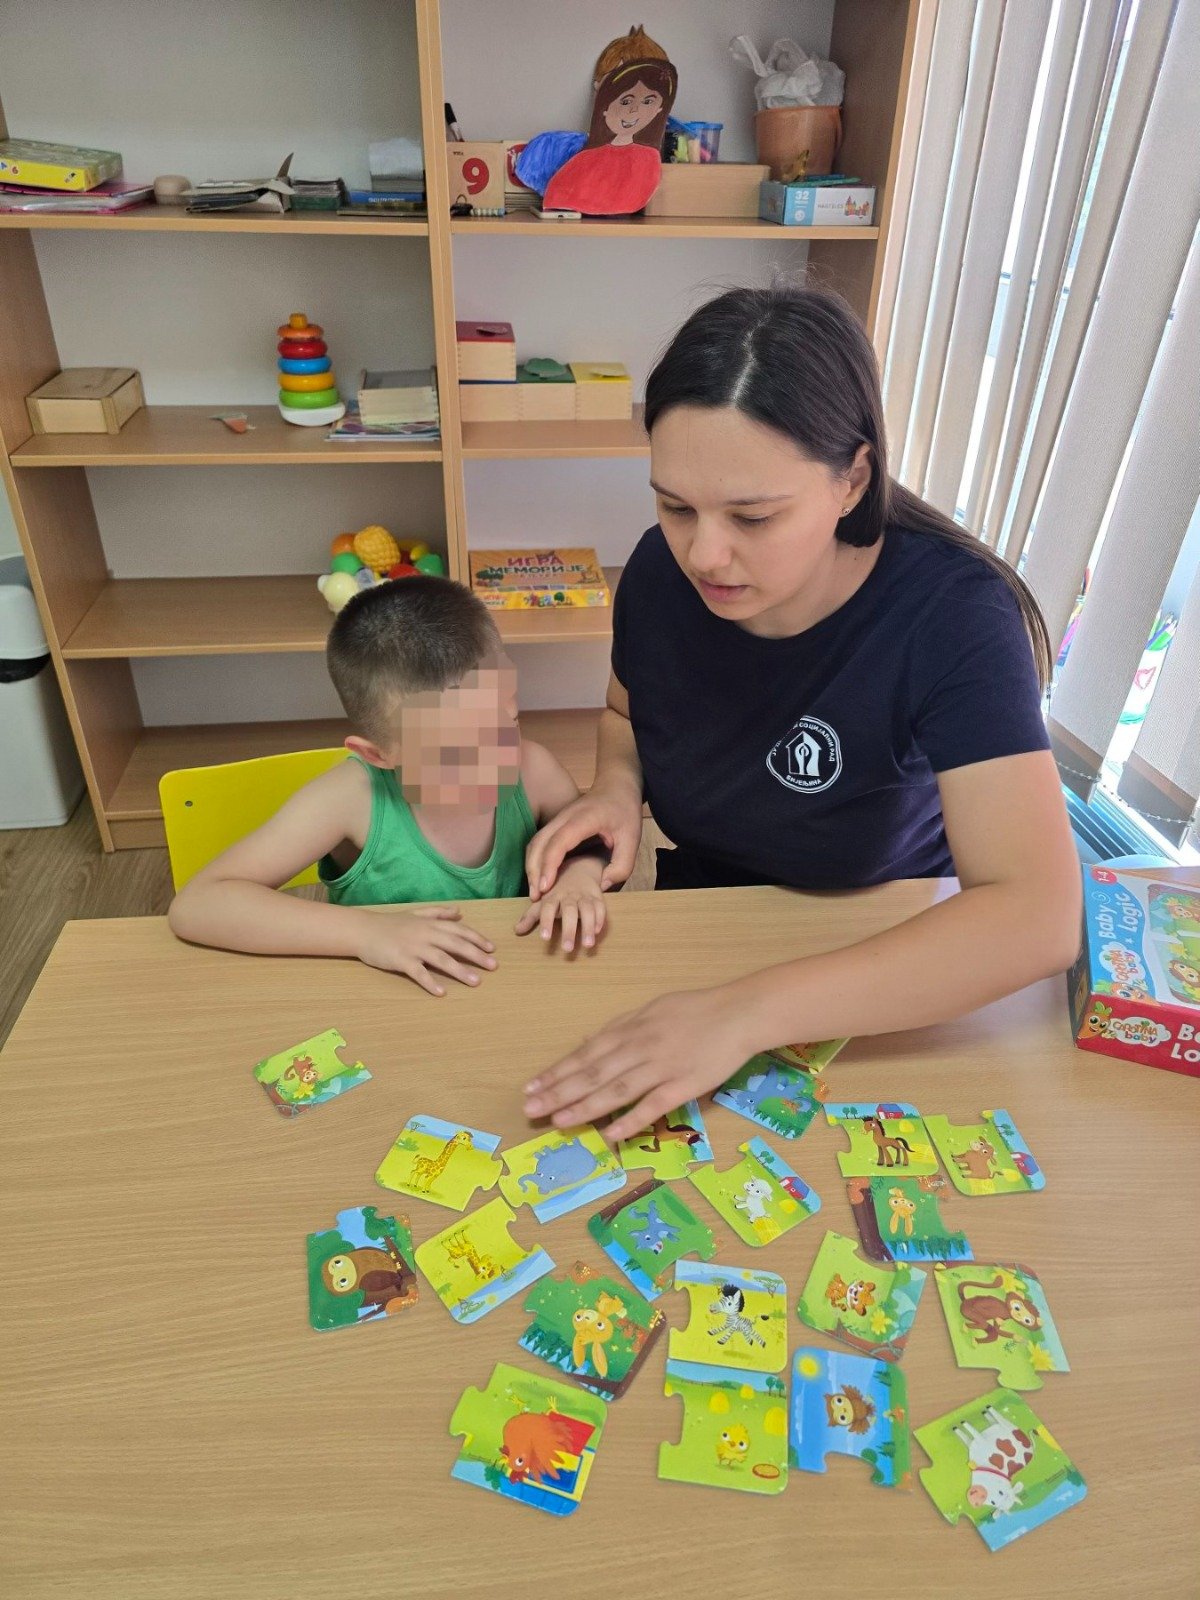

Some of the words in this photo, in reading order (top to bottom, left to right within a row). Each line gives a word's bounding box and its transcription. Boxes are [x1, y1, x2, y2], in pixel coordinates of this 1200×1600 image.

[462, 158, 489, 195] 9
[795, 190, 809, 200] 32
[508, 556, 564, 567] ИГРА
[1095, 905, 1117, 939] Baby
[1115, 893, 1142, 933] Logic
[1125, 1031, 1156, 1044] baby
